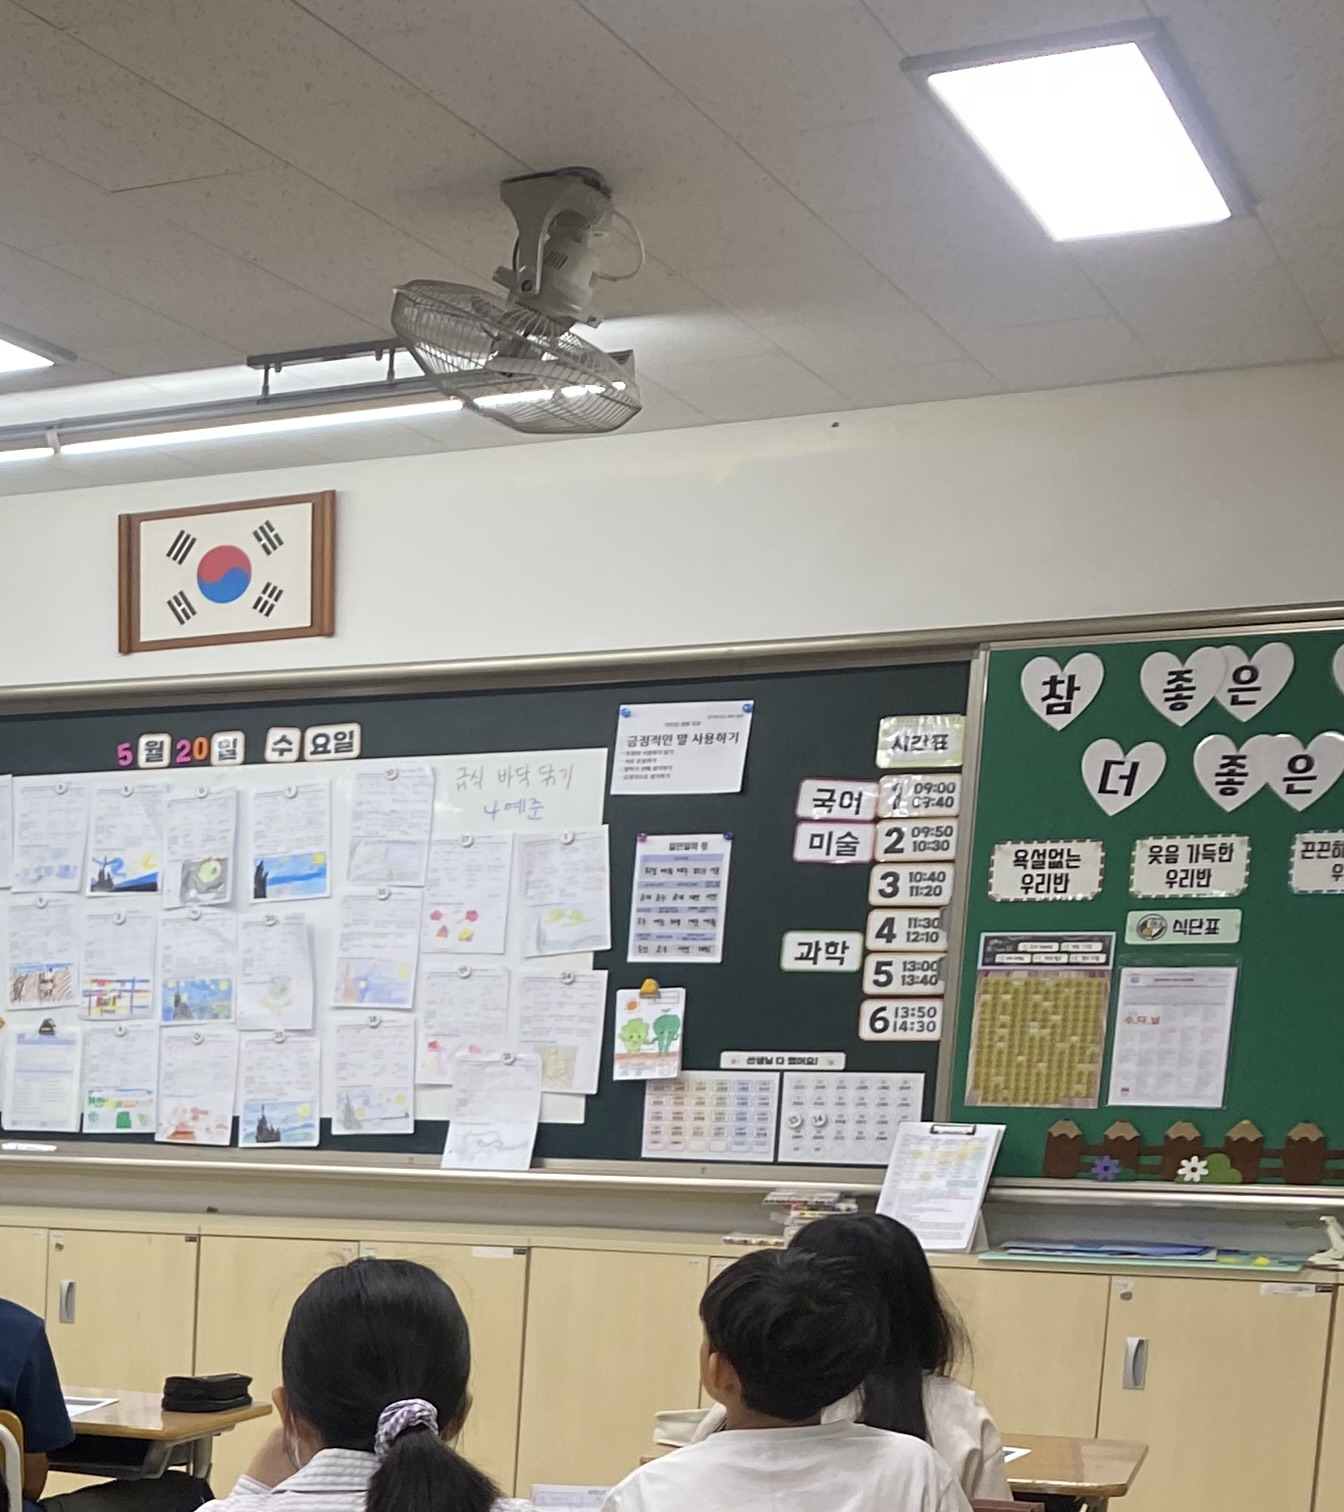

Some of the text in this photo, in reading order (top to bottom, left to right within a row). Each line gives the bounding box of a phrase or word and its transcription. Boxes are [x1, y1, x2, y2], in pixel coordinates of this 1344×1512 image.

[1040, 663, 1263, 716] 참 좋은
[890, 732, 950, 753] 시간표
[455, 762, 575, 792] 급식 바닥 닦기
[1097, 753, 1319, 798] 더 좋은
[913, 782, 956, 795] 09:00
[812, 787, 863, 815] 국어
[808, 830, 861, 857] 미술
[883, 825, 954, 854] 2 09:50
[912, 839, 951, 852] 10:30
[1012, 847, 1083, 870] 욕설없는
[1147, 843, 1234, 865] 웃음 가득한
[877, 871, 946, 898] 3 10:40
[1019, 872, 1071, 896] 우리반
[1164, 867, 1213, 889] 우리반
[908, 885, 943, 898] 11:20
[874, 916, 940, 944] 4 11:30
[905, 931, 939, 943] 12:10
[1172, 917, 1222, 937] 식단표
[794, 940, 850, 966] 과학
[871, 960, 939, 987] 5 13:00
[900, 974, 939, 986] 13:40
[869, 1006, 937, 1034] 6 13:50
[893, 1020, 936, 1033] 14:30
